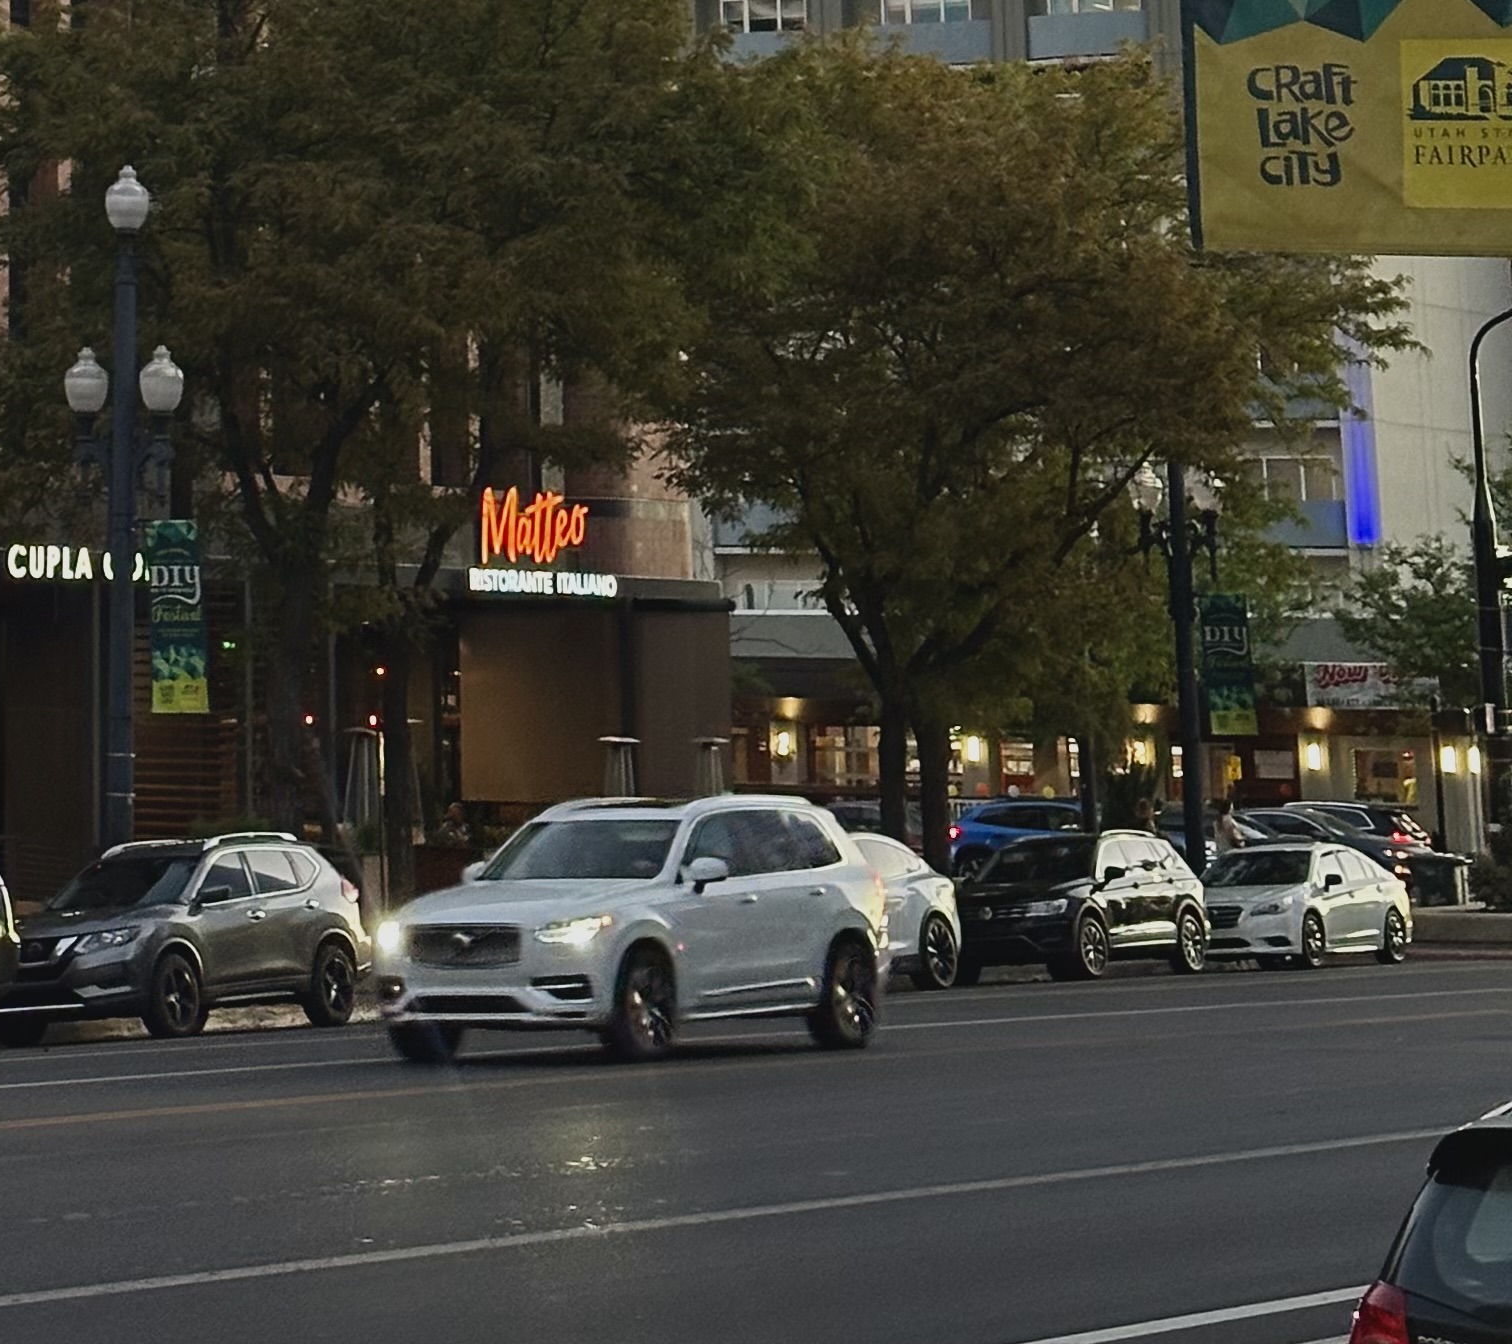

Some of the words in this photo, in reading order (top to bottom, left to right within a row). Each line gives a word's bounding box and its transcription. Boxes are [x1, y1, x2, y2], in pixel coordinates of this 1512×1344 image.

[1414, 127, 1466, 138] UTAH
[1481, 127, 1512, 138] ST
[1415, 145, 1512, 168] FAIRPA
[481, 486, 589, 564] Matteo
[7, 543, 93, 580] CUPLA
[150, 565, 202, 599] DIY
[468, 567, 554, 595] RISTORANTE
[556, 572, 618, 598] ITALIANO
[1203, 626, 1248, 652] DIY
